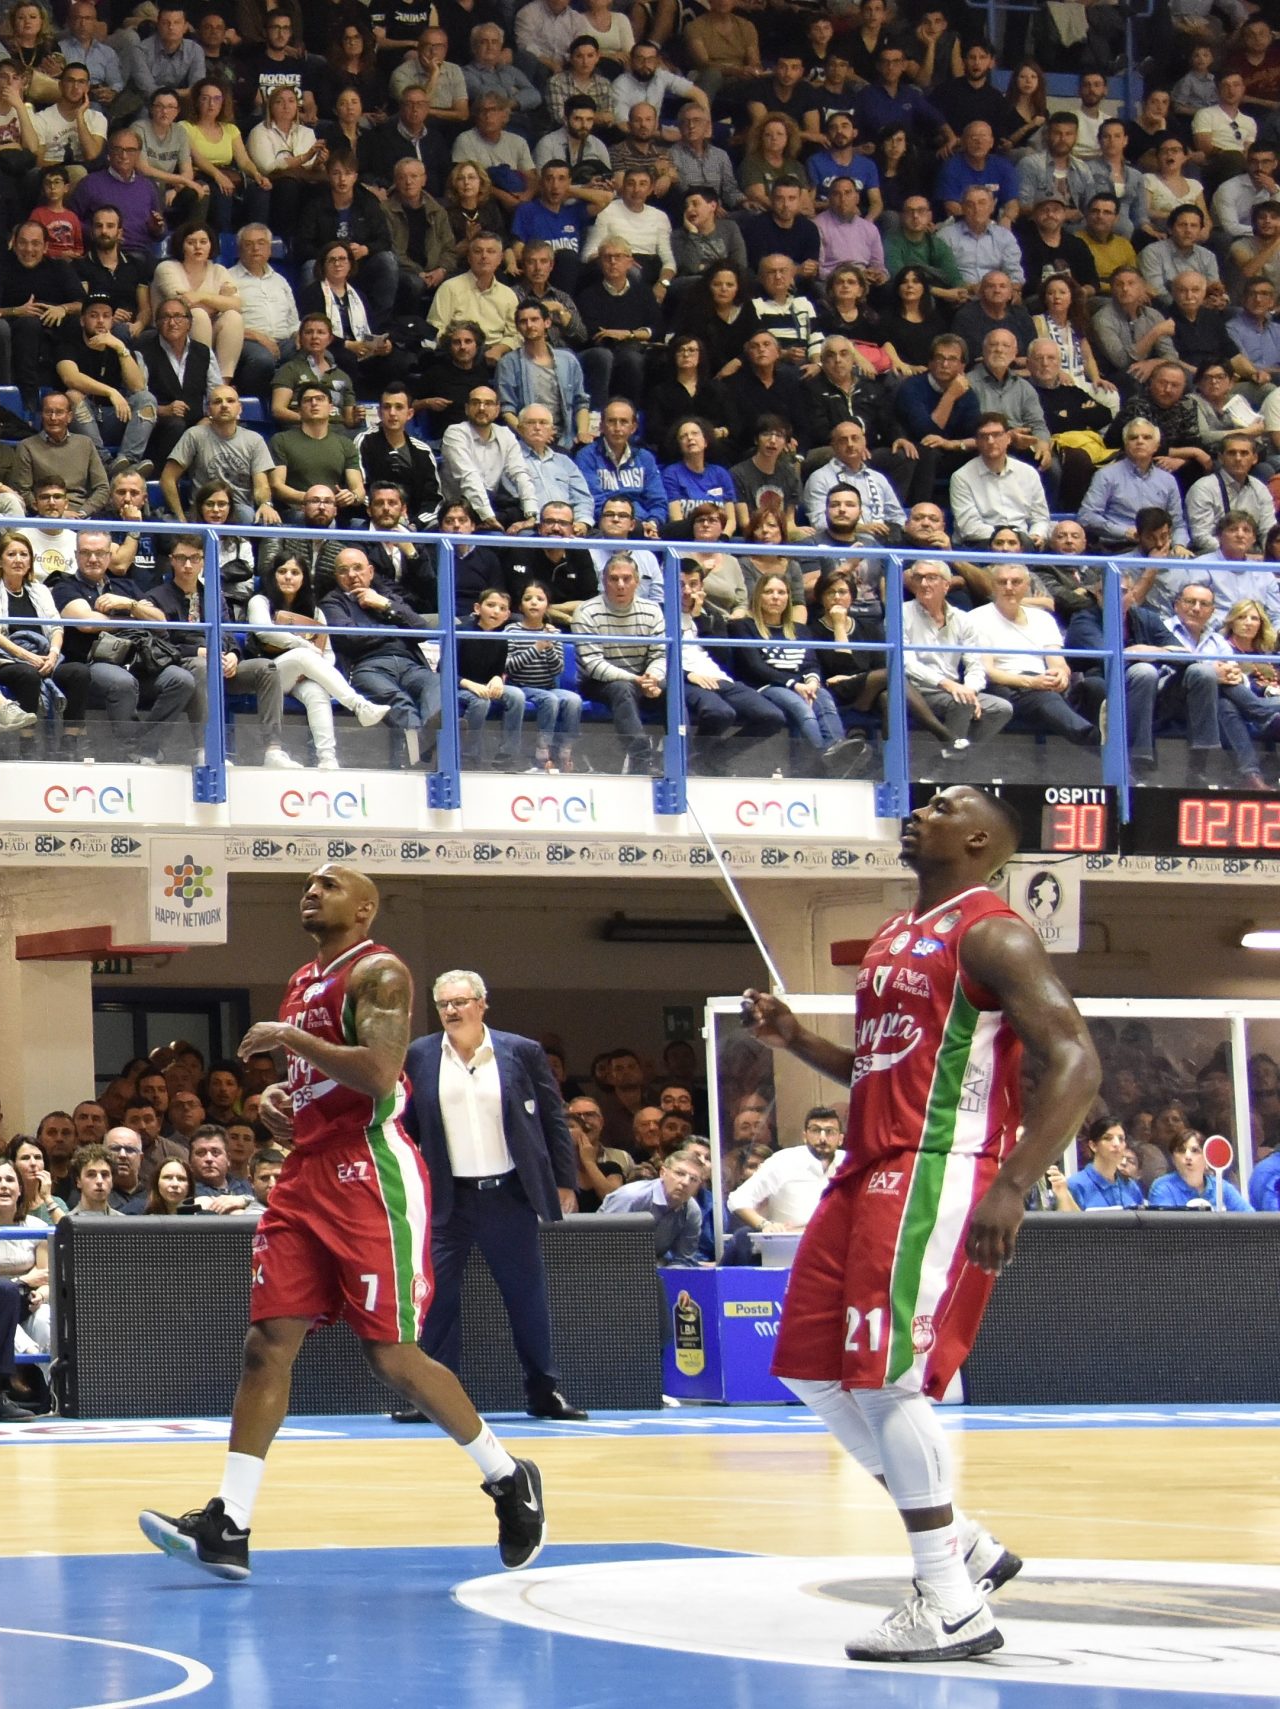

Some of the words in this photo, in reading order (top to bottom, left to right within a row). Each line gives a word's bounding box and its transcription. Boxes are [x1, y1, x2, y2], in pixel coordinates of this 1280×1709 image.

[44, 778, 135, 814] enel
[280, 783, 368, 819] enel
[1045, 788, 1106, 804] OSPITI
[510, 788, 597, 823] enel
[735, 794, 819, 828] enel
[1054, 804, 1103, 851] 30
[4, 842, 28, 851] FADI
[35, 836, 52, 852] 85
[82, 843, 106, 852] FADI
[111, 837, 128, 854] 85
[226, 846, 250, 855] FADI
[252, 840, 270, 857] 85
[328, 842, 344, 858] 85
[401, 842, 417, 859] 85
[474, 844, 490, 860] 85
[546, 845, 562, 861] 85
[618, 846, 634, 862] 85
[690, 848, 706, 864] 85
[761, 849, 777, 865] 85
[832, 850, 848, 866] 85
[155, 905, 181, 926] HAPPY
[183, 907, 221, 927] NETWORK
[1038, 926, 1061, 939] ADI
[911, 939, 938, 956] SAP
[892, 980, 930, 999] EYEWEAR
[867, 1171, 904, 1189] EA7
[360, 1274, 378, 1311] 7
[735, 1303, 770, 1315] Poste
[680, 1324, 696, 1336] LBA
[845, 1306, 882, 1351] 21
